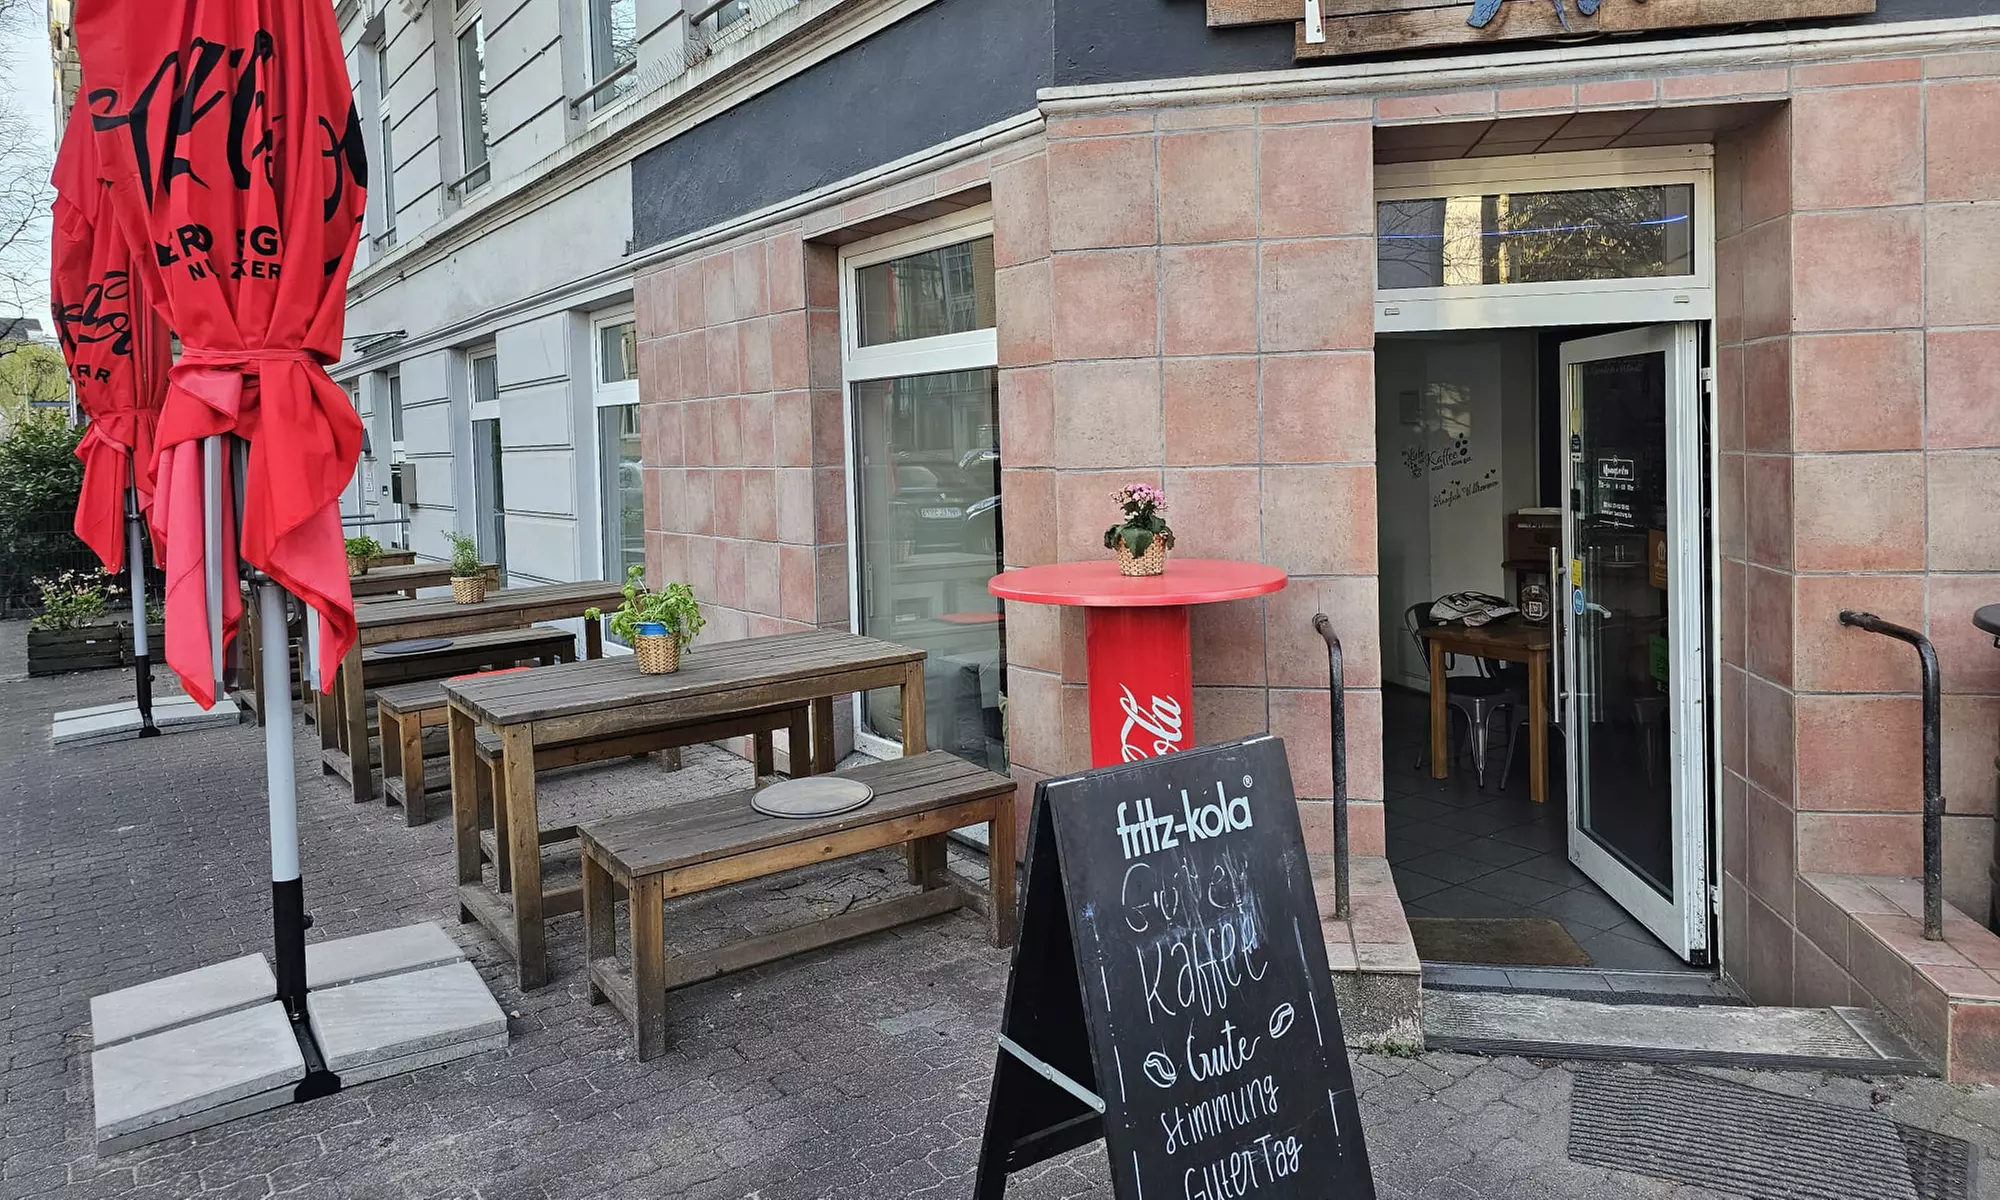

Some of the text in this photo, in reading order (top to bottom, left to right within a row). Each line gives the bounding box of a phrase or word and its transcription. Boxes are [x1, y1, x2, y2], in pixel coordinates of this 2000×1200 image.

[1116, 780, 1253, 860] fritz-kola
[1136, 916, 1268, 1024] Kaffee
[1186, 1019, 1261, 1082] Gute
[1253, 1133, 1304, 1183] Tag
